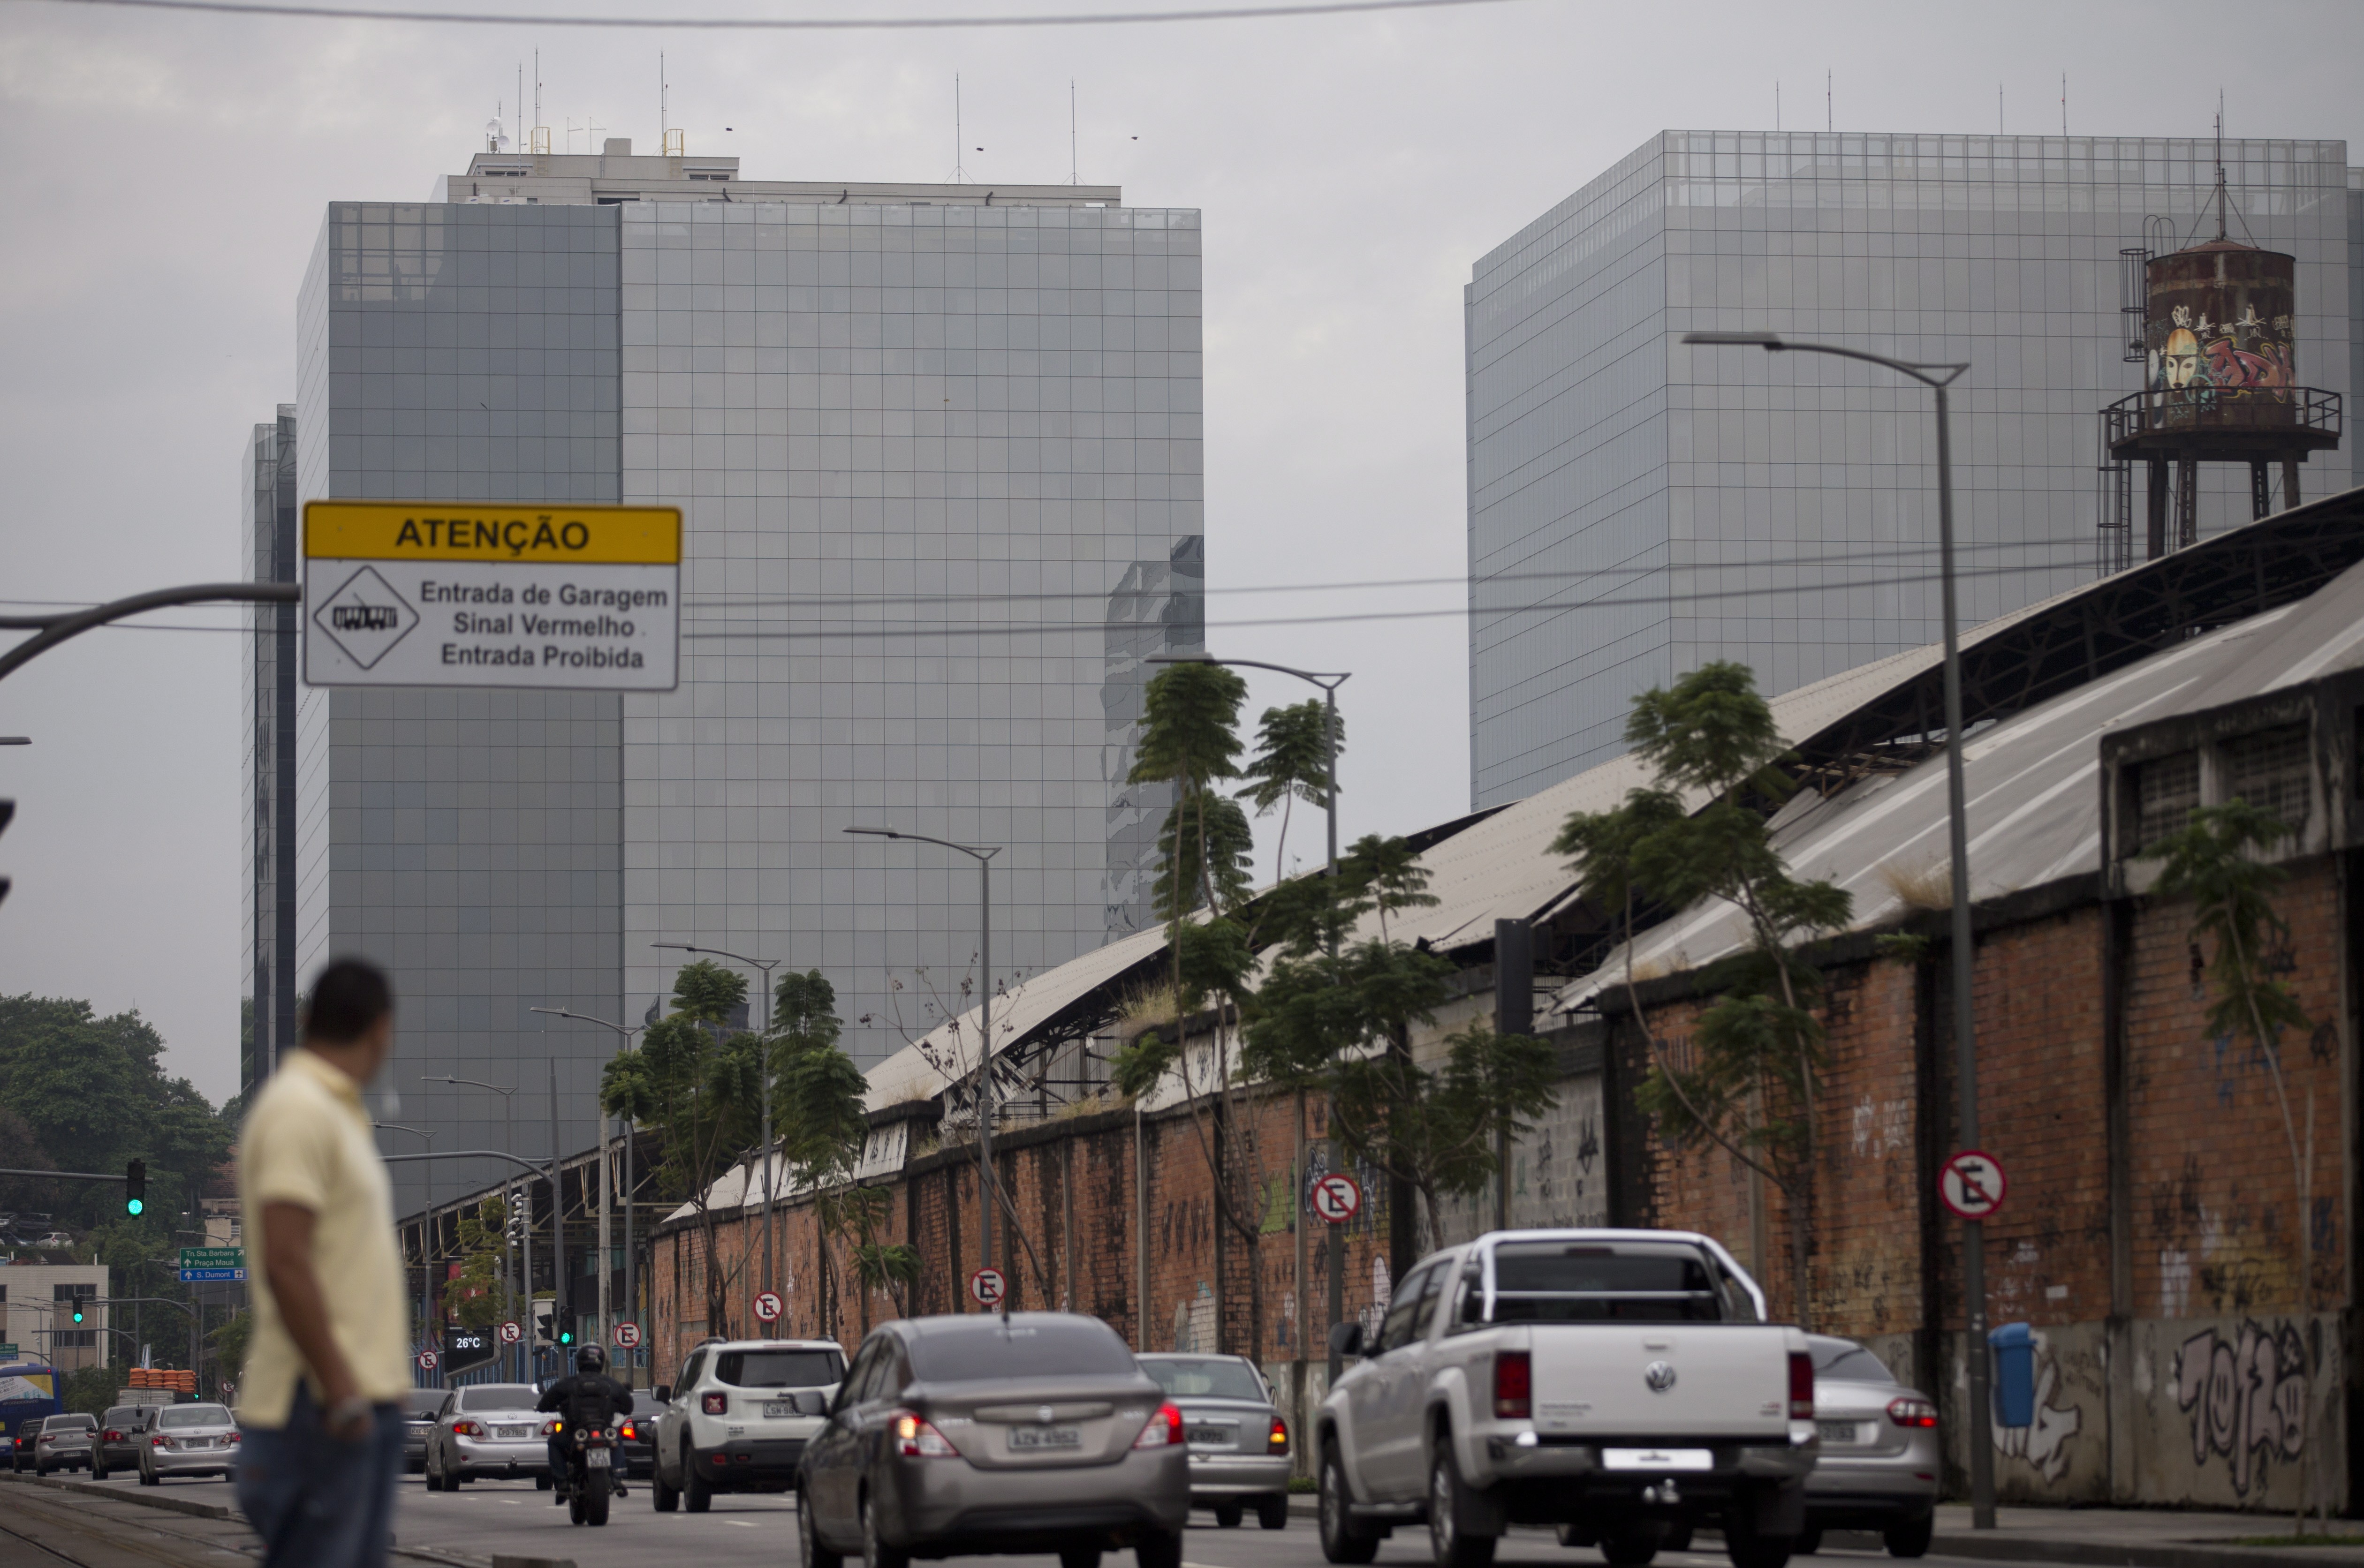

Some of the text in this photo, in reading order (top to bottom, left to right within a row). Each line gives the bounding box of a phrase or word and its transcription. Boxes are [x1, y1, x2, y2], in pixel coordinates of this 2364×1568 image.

[396, 516, 589, 557] ATENÇÃO
[421, 581, 667, 611] Entrada de Garagem
[454, 612, 635, 637] Sinal Vermelho
[442, 643, 644, 668] Entrada Proibida
